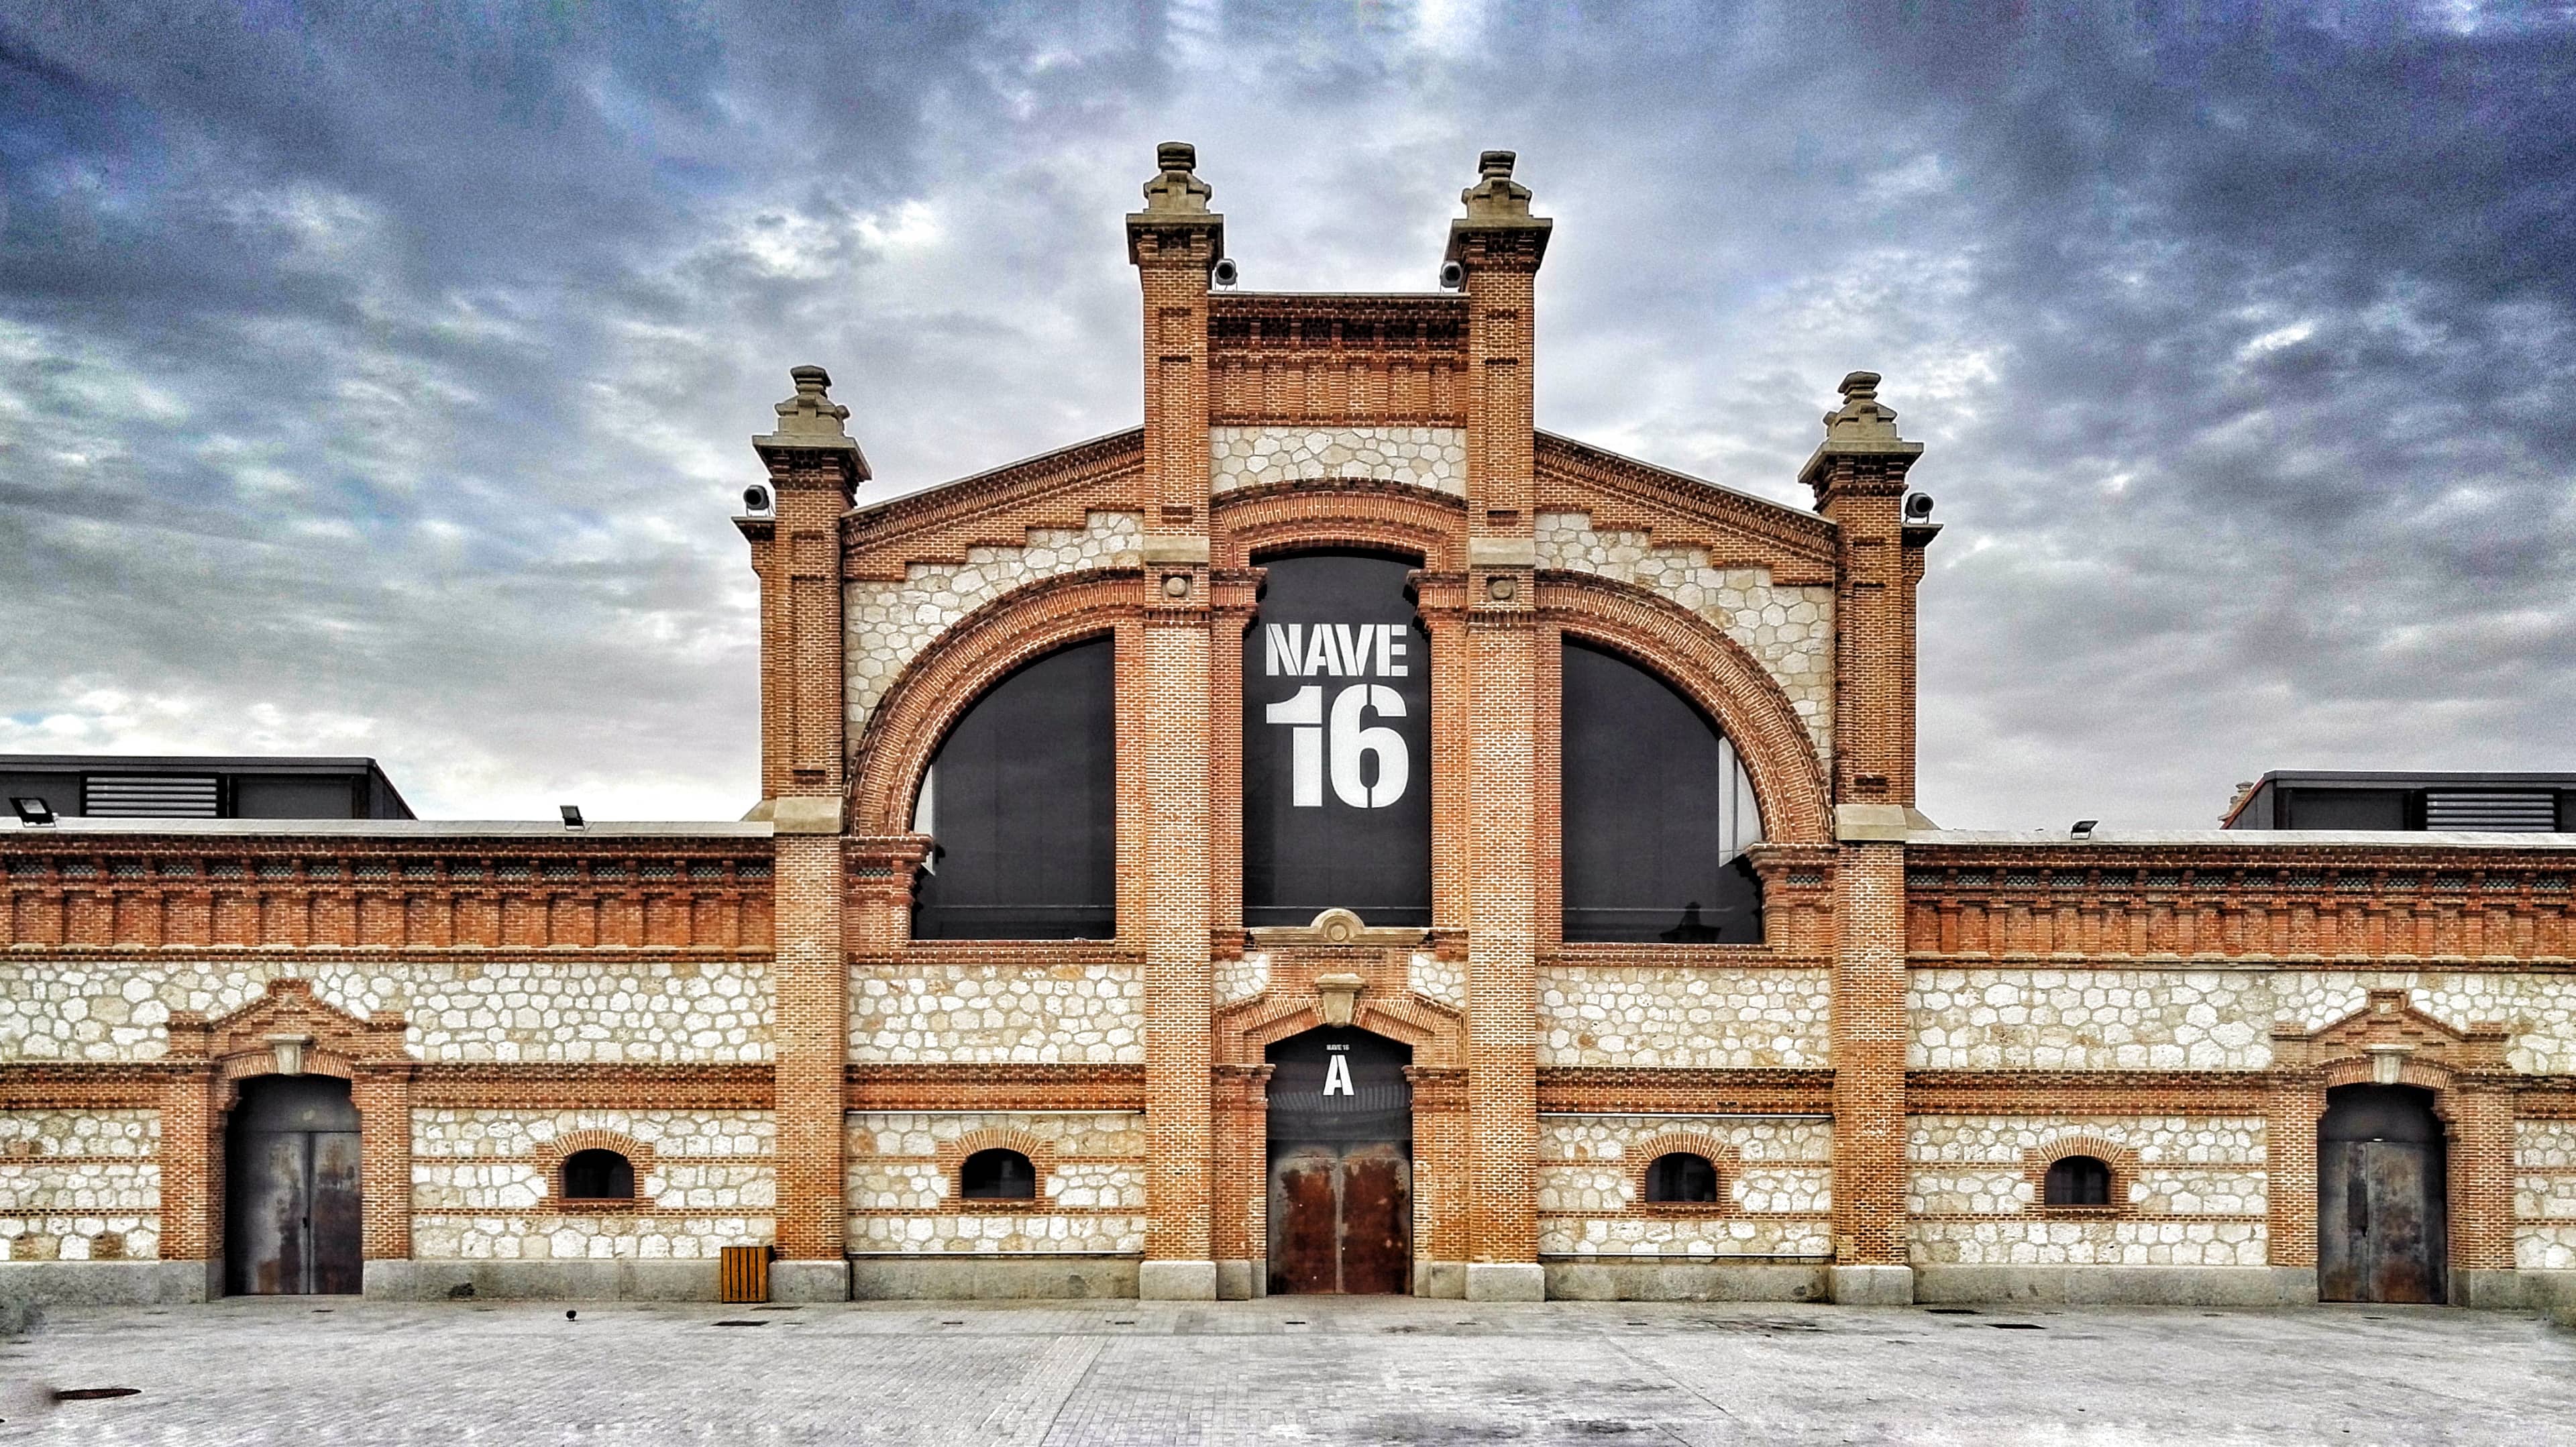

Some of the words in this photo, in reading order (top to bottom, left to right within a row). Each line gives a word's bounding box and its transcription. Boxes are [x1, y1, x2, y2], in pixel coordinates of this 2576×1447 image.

[1266, 623, 1408, 677] NAVE
[1266, 684, 1409, 808] 16
[1323, 1055, 1354, 1095] A
